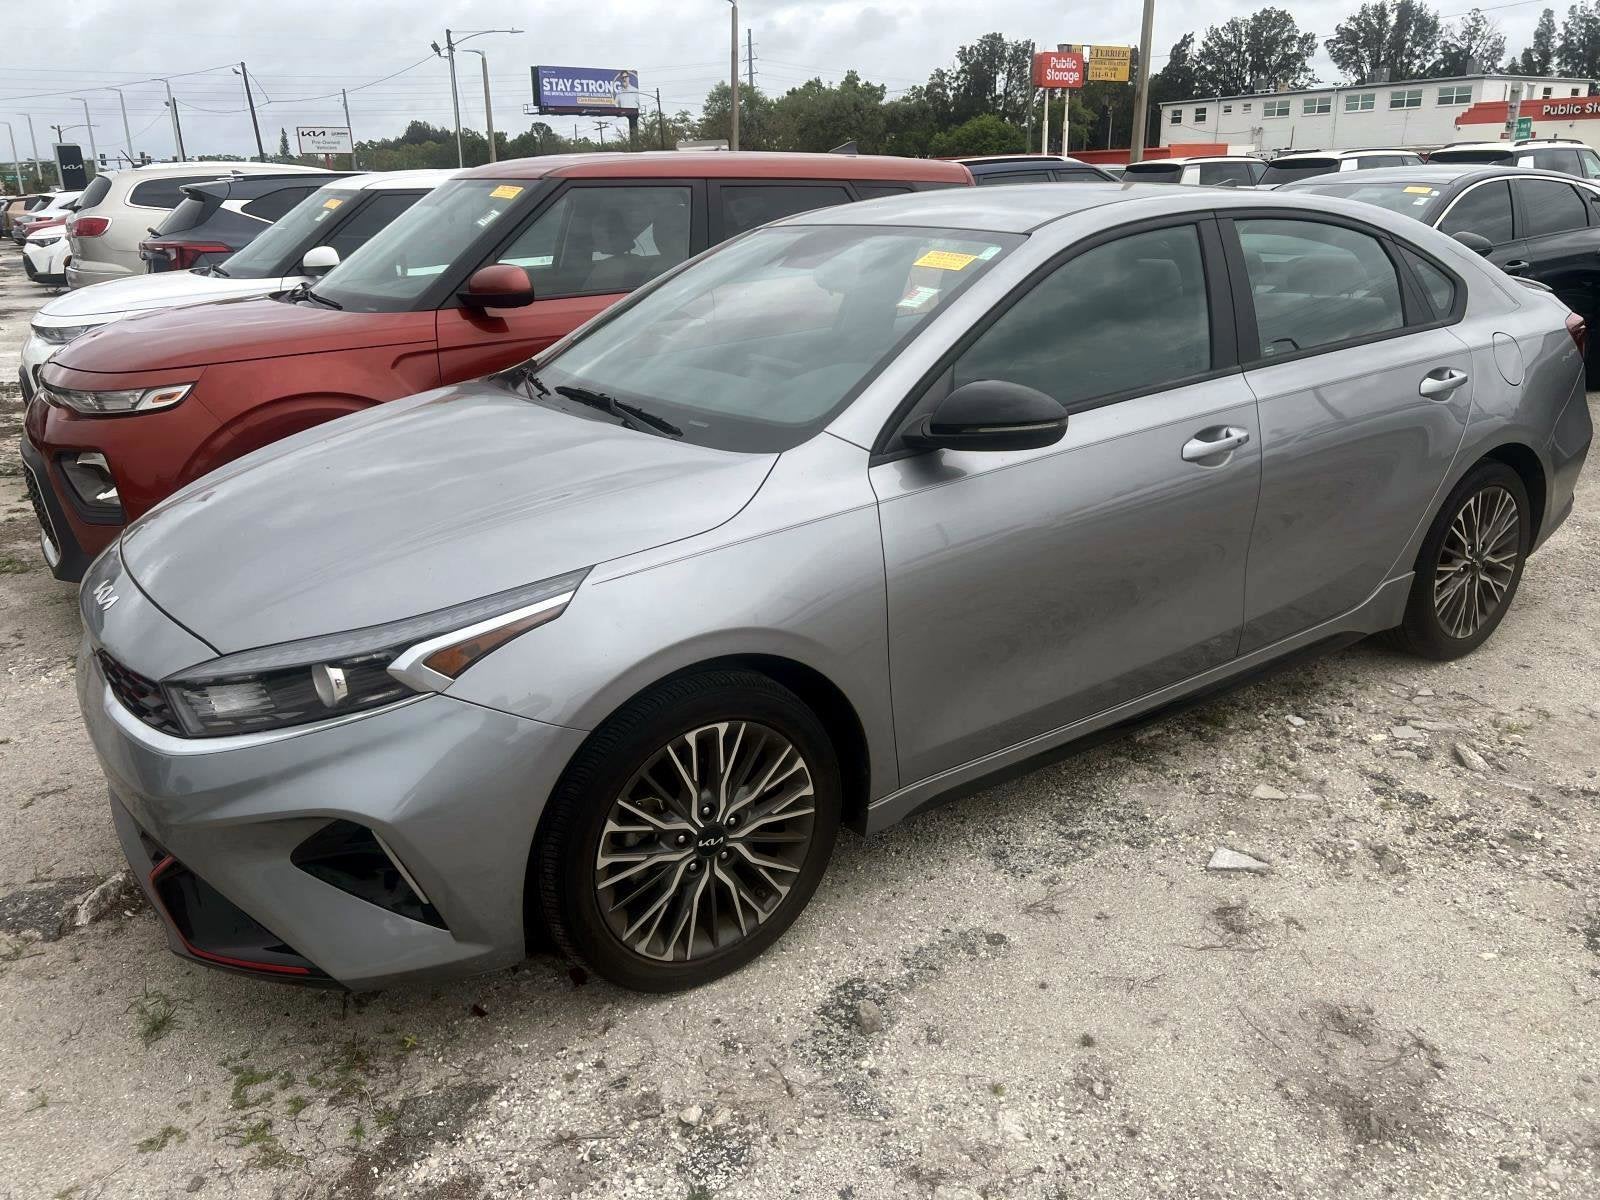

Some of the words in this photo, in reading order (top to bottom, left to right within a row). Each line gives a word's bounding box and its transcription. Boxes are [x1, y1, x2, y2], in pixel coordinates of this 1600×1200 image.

[1050, 57, 1077, 69] Public
[1046, 69, 1080, 83] Storage
[542, 77, 573, 92] STAY
[573, 78, 622, 94] STRONG
[1542, 103, 1582, 116] Public
[93, 579, 120, 611] KIA
[698, 836, 724, 847] KIA
